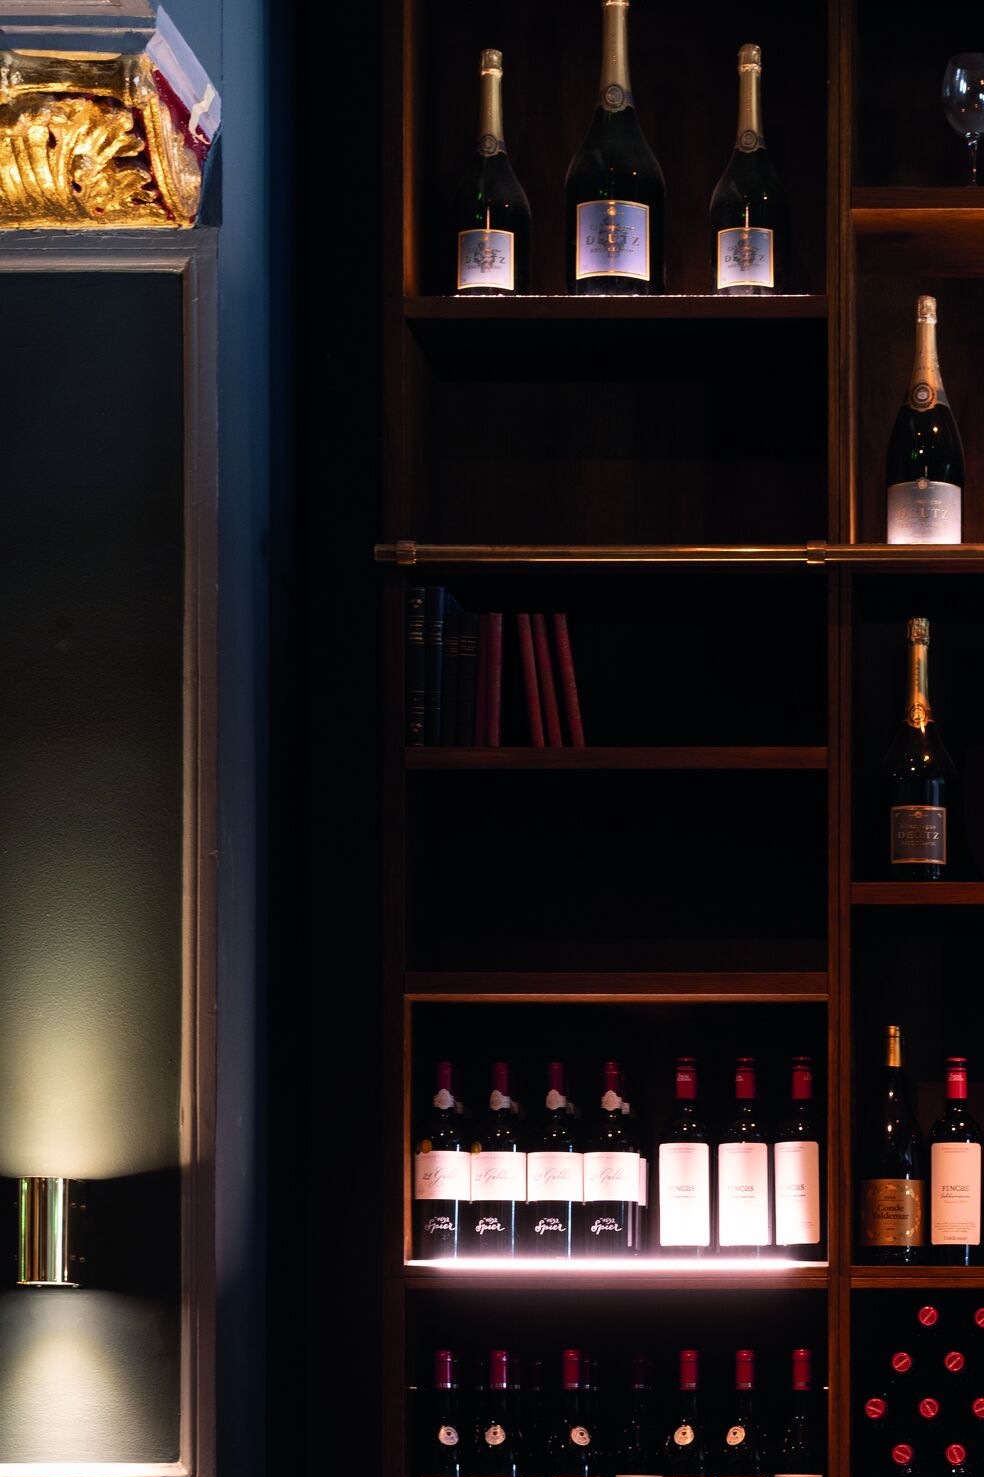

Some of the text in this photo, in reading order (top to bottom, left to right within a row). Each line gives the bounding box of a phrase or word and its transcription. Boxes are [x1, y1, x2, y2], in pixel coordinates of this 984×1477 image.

[876, 1204, 905, 1212] Conde
[424, 1219, 456, 1235] Spier
[475, 1219, 507, 1236] Spier
[534, 1219, 567, 1236] Spier
[590, 1219, 623, 1236] Spier
